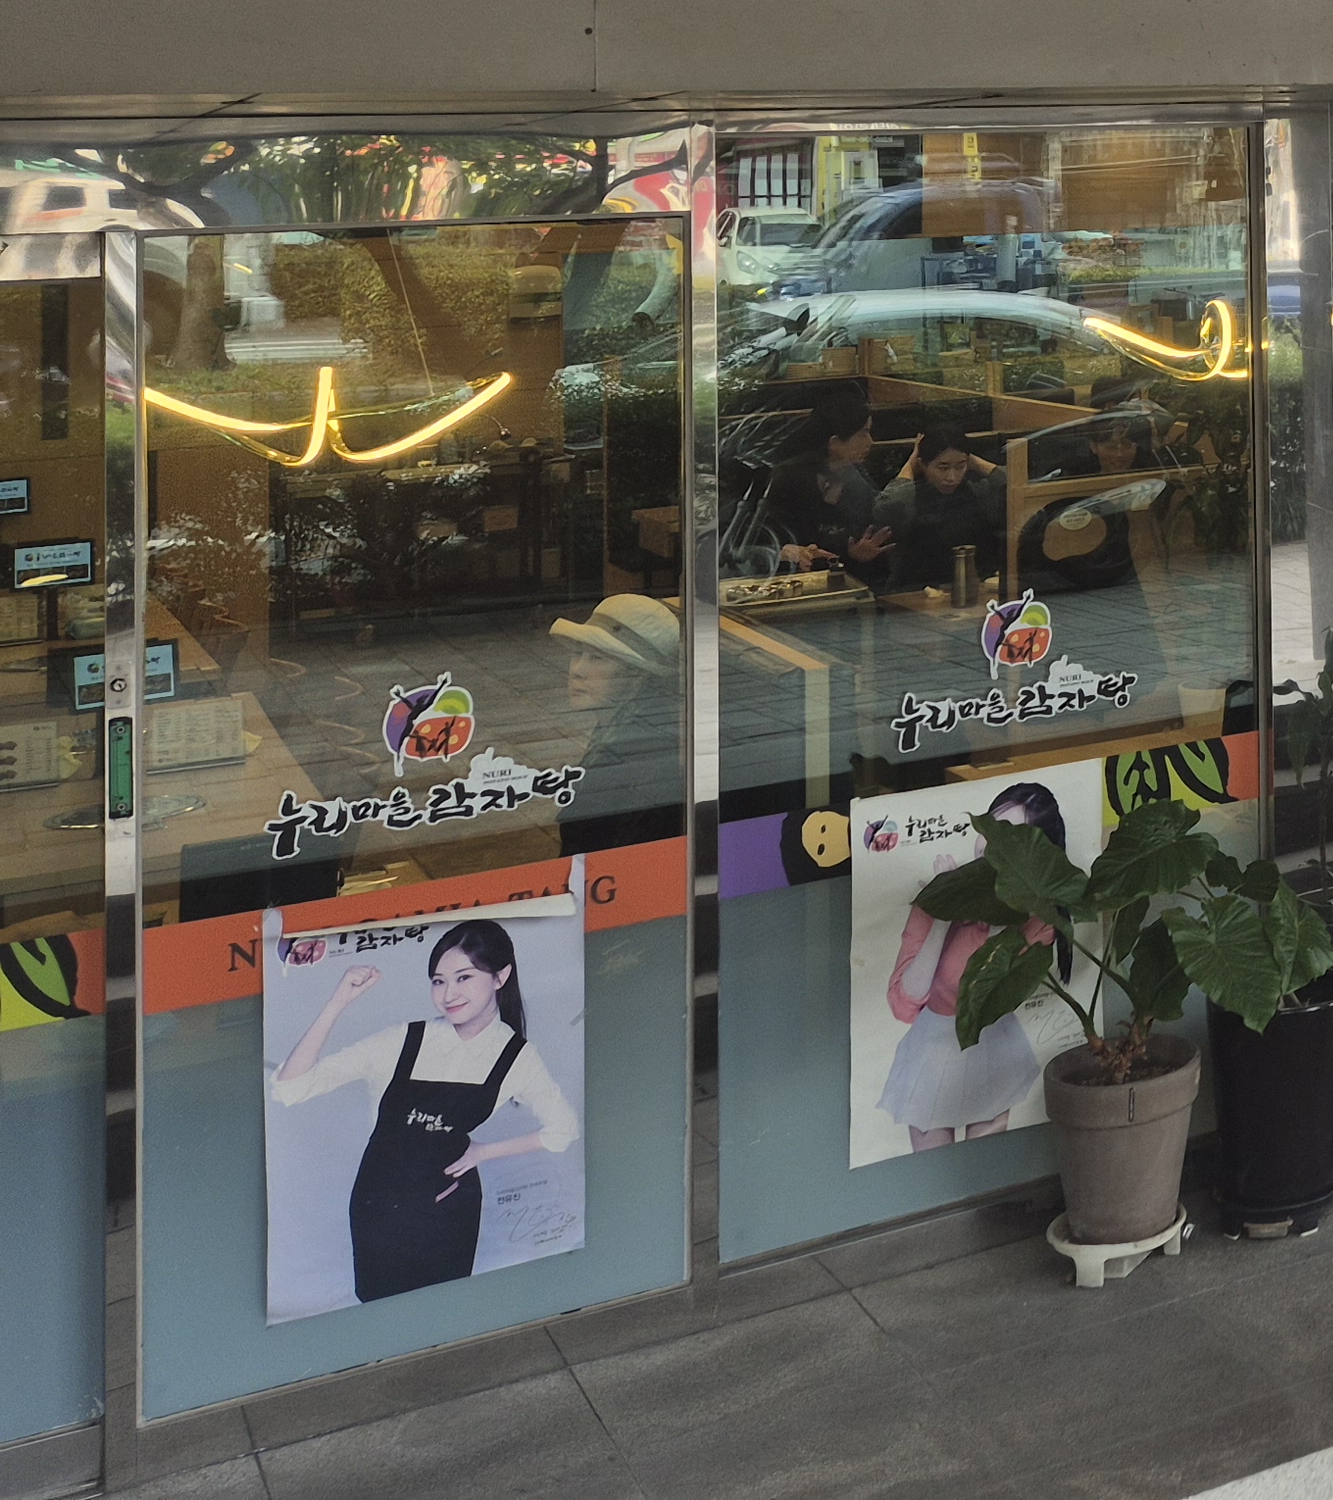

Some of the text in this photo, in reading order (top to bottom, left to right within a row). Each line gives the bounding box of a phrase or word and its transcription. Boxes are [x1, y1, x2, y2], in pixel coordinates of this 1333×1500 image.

[893, 672, 1137, 751] 누리마을 감자탕
[267, 768, 582, 858] 누리마을 감자탕
[905, 814, 948, 837] 누리마을
[919, 820, 972, 844] 감자탕
